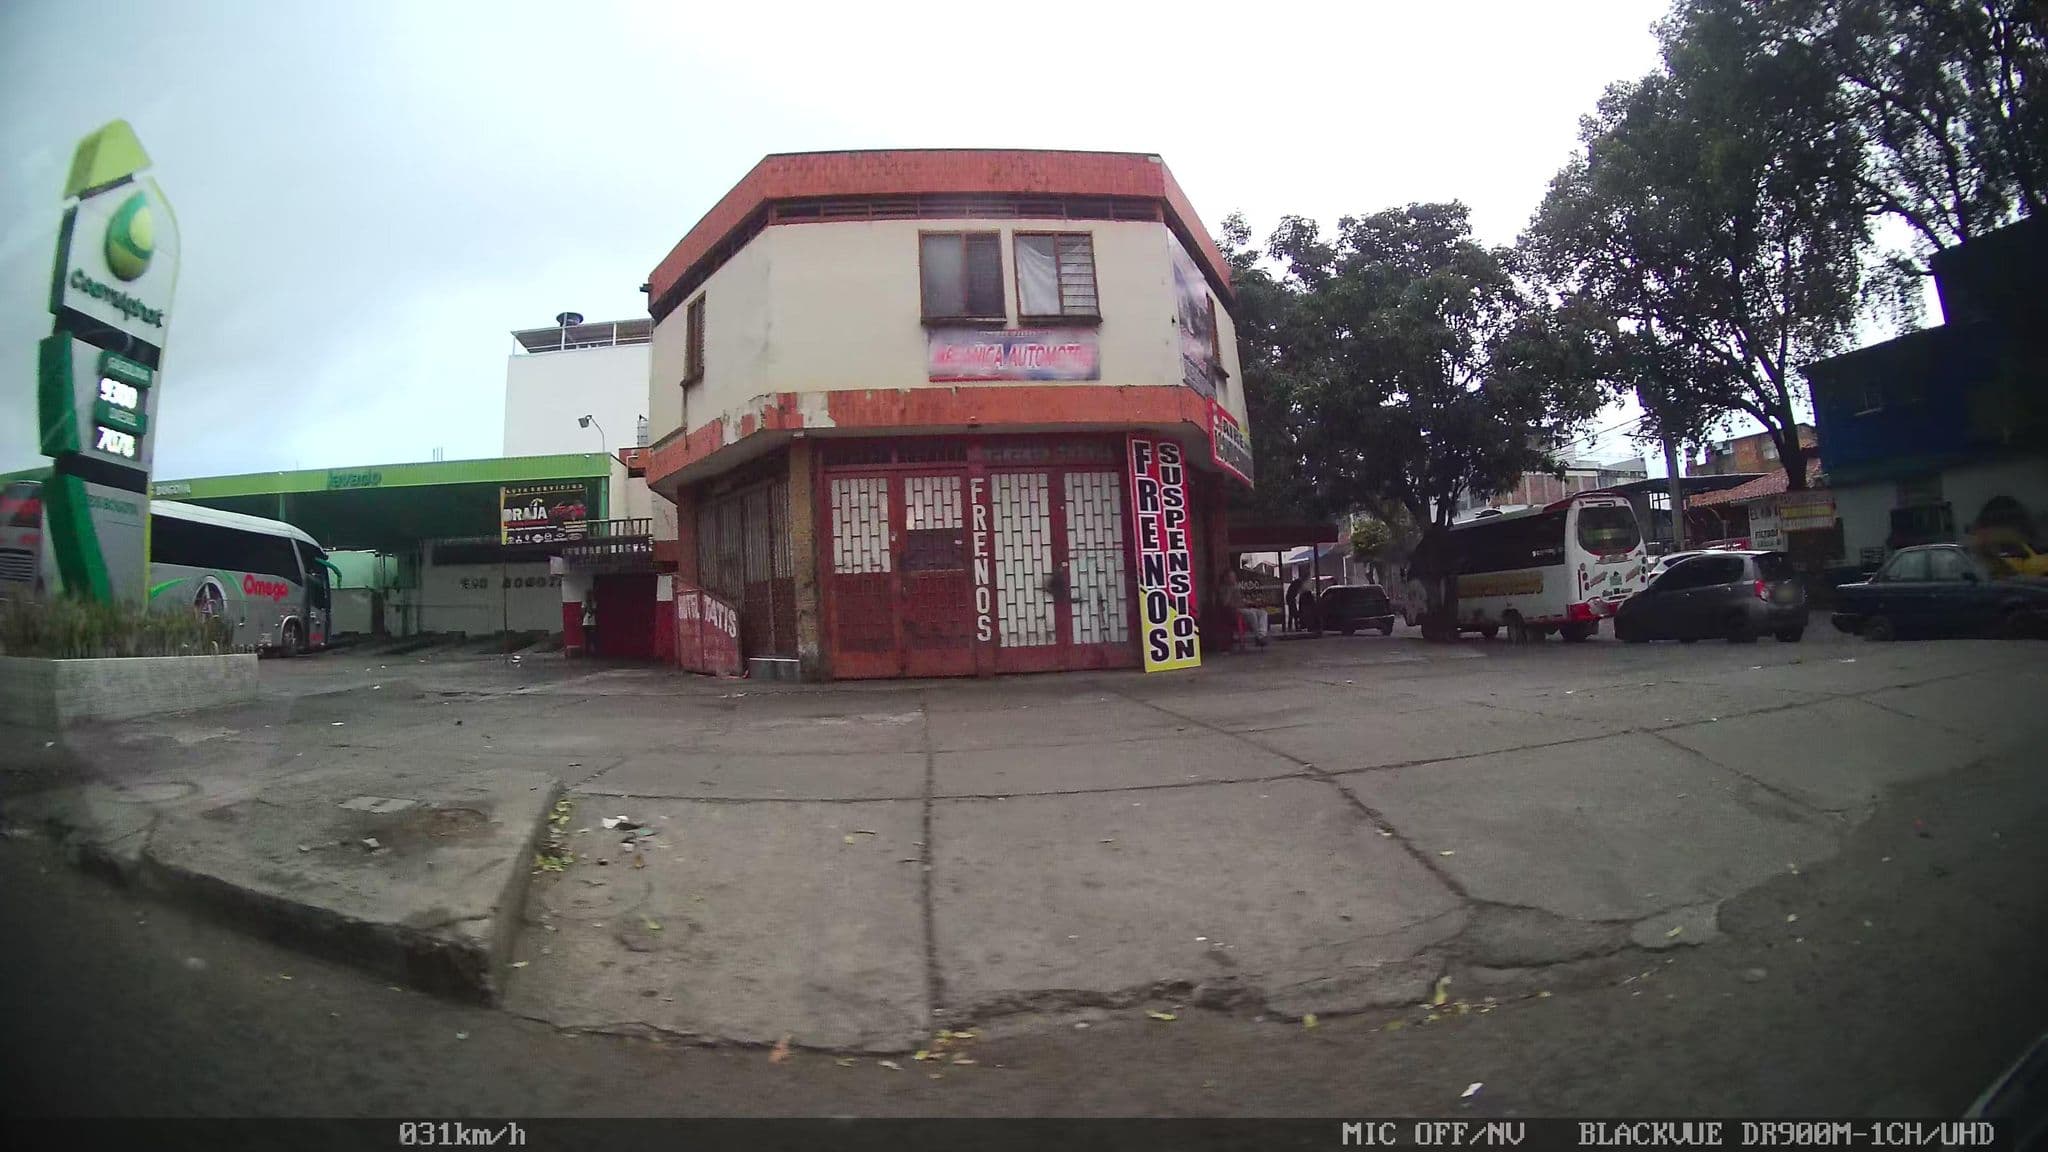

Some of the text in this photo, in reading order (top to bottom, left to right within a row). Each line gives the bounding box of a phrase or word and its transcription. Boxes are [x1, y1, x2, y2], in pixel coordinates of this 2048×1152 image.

[243, 574, 289, 602] Omega
[970, 478, 992, 642] FRENOS
[1132, 440, 1170, 663] FRENOS
[1157, 443, 1196, 662] SUSPENSION
